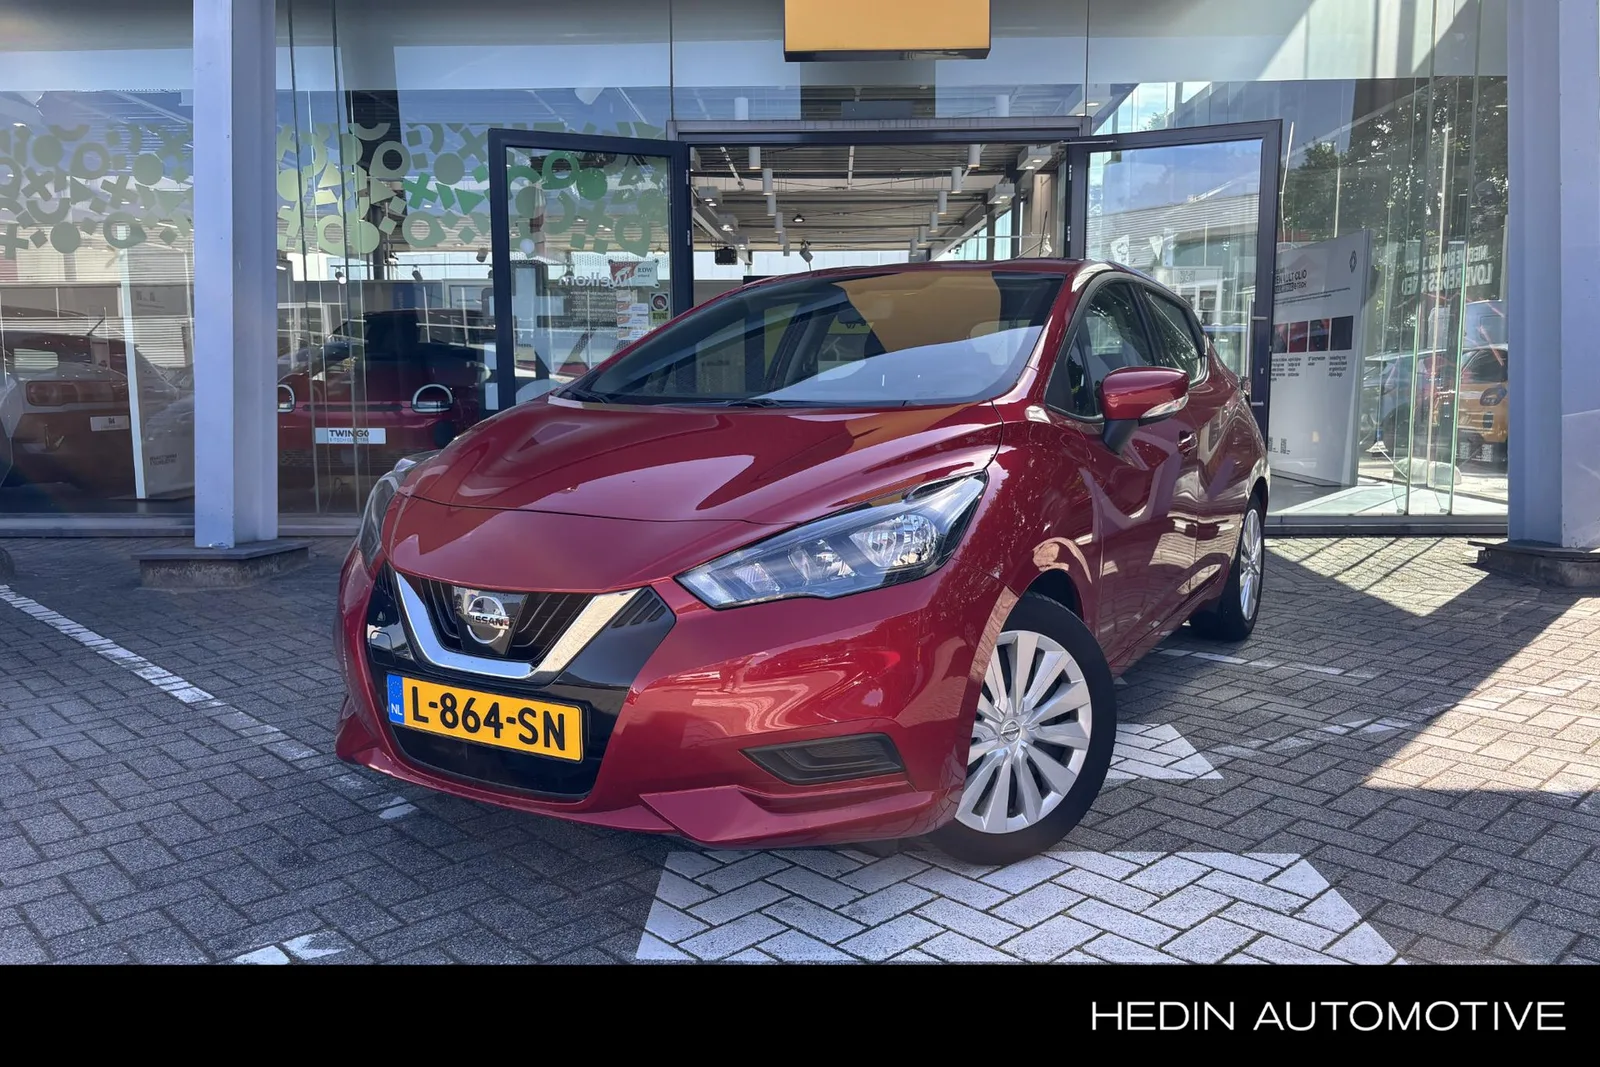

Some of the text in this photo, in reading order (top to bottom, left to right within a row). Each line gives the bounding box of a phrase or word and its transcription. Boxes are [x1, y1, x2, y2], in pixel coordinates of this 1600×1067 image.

[329, 429, 370, 438] TWINGO
[391, 702, 403, 717] NL
[411, 685, 566, 751] L-864-SN
